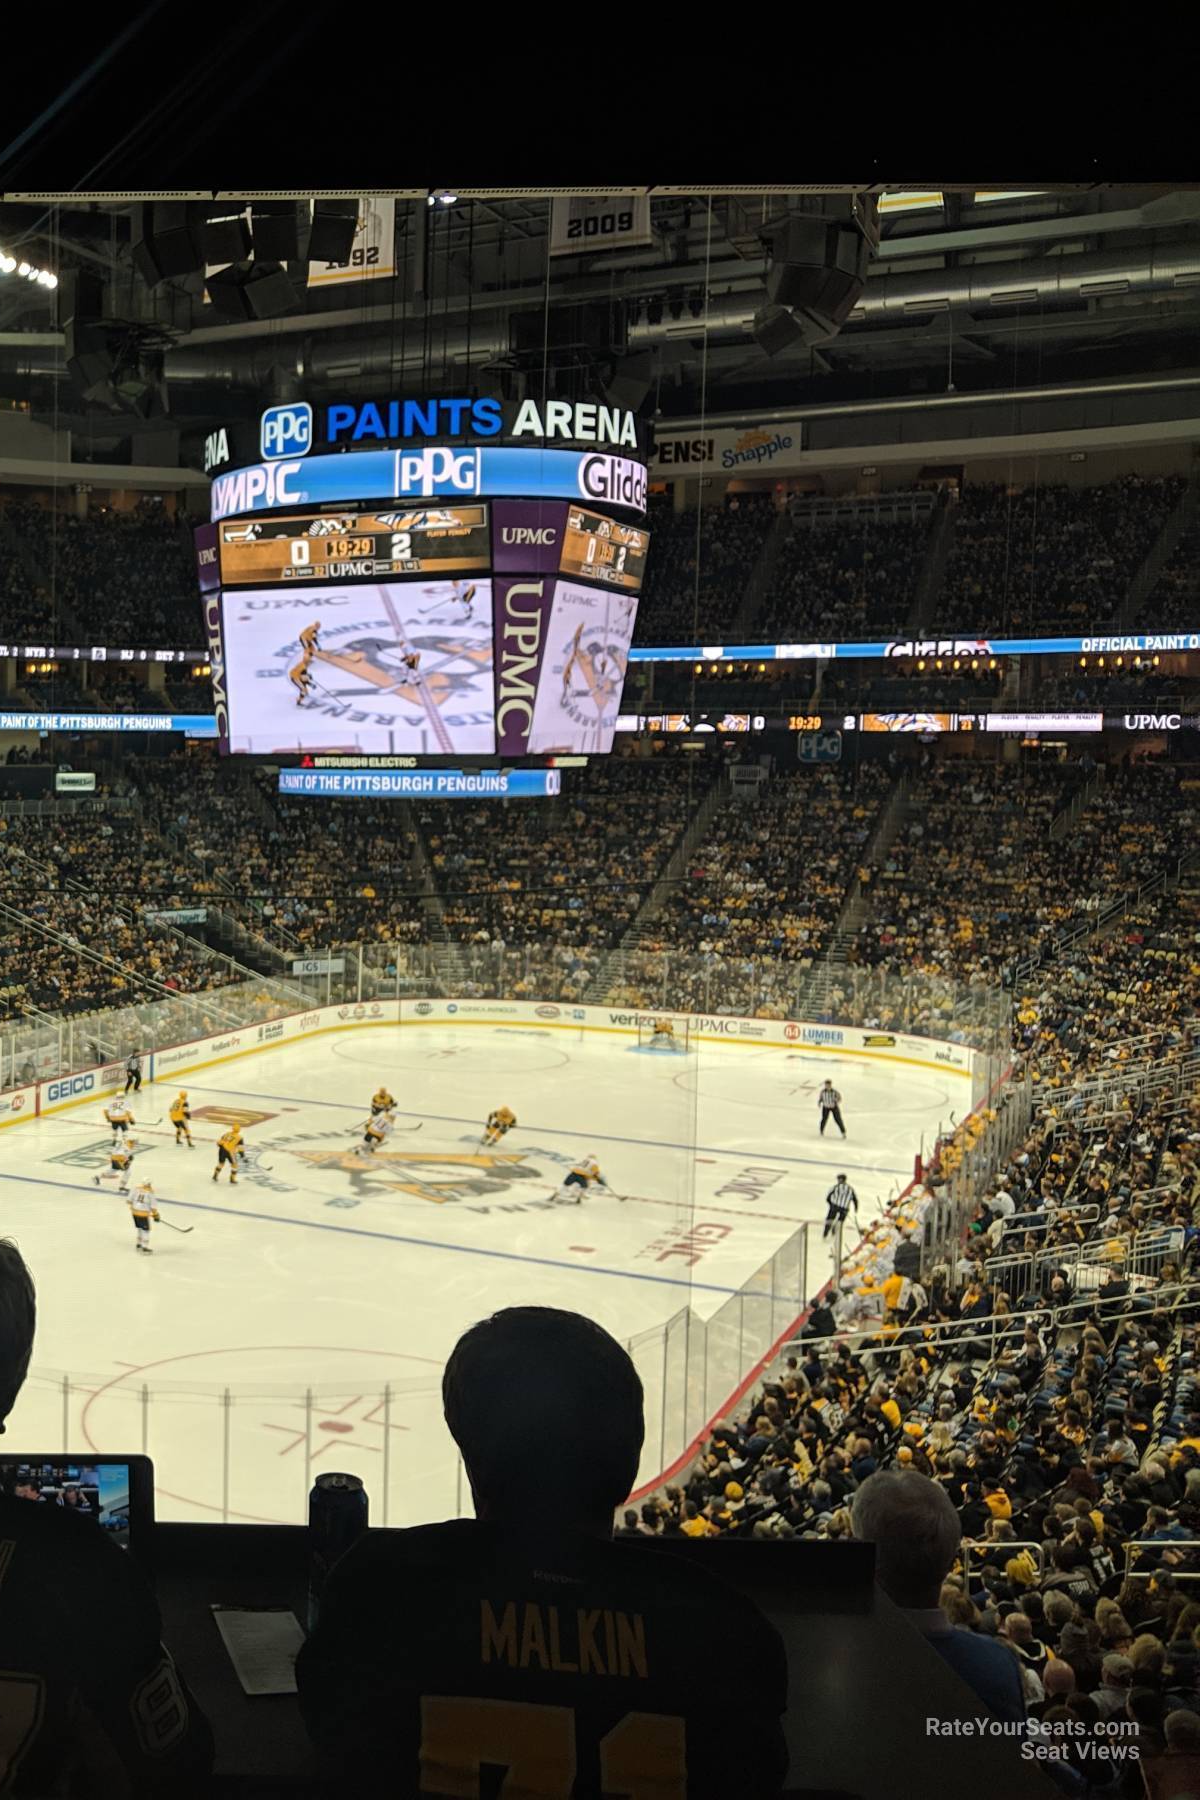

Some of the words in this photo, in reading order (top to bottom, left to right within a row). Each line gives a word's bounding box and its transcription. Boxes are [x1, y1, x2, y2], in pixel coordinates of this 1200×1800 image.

[568, 211, 633, 238] 2009
[265, 412, 309, 454] PPG
[327, 398, 503, 443] PAINTS
[511, 399, 638, 448] ARENA
[722, 433, 793, 468] Snapple
[401, 448, 476, 497] PPG
[391, 533, 412, 560] 2
[502, 527, 557, 546] UPMC
[291, 540, 310, 566] 0
[330, 540, 371, 557] 19:29
[586, 537, 597, 563] 0
[616, 546, 627, 572] 2
[329, 561, 374, 578] UPMC
[244, 595, 350, 610] UPMC
[1081, 638, 1142, 652] OFFICIAL
[1145, 635, 1187, 650] PAINT
[205, 598, 229, 739] UPMC
[497, 580, 544, 738] UPMC
[1, 715, 27, 728] PAINT
[28, 715, 39, 728] OF
[39, 715, 57, 728] THE
[60, 716, 121, 729] PITTSBURGH
[123, 716, 172, 729] PENGUINS
[753, 716, 765, 730] 0
[789, 716, 822, 731] 19:29
[844, 716, 856, 730] 2
[1124, 714, 1181, 730] UPMC
[801, 735, 839, 757] PPG
[314, 757, 367, 768] MITSUBISHI
[369, 756, 417, 768] ELECTRIC
[304, 776, 318, 791] OF
[319, 776, 340, 791] THE
[343, 777, 433, 793] PITTSBURGH
[437, 776, 508, 792] PENGUINS
[609, 1012, 656, 1028] verizo
[688, 1018, 738, 1034] UPMC
[802, 1028, 844, 1042] LUMBER
[48, 1074, 95, 1101] GEICO
[655, 1222, 734, 1267] GNC
[479, 1598, 650, 1680] MALKIN
